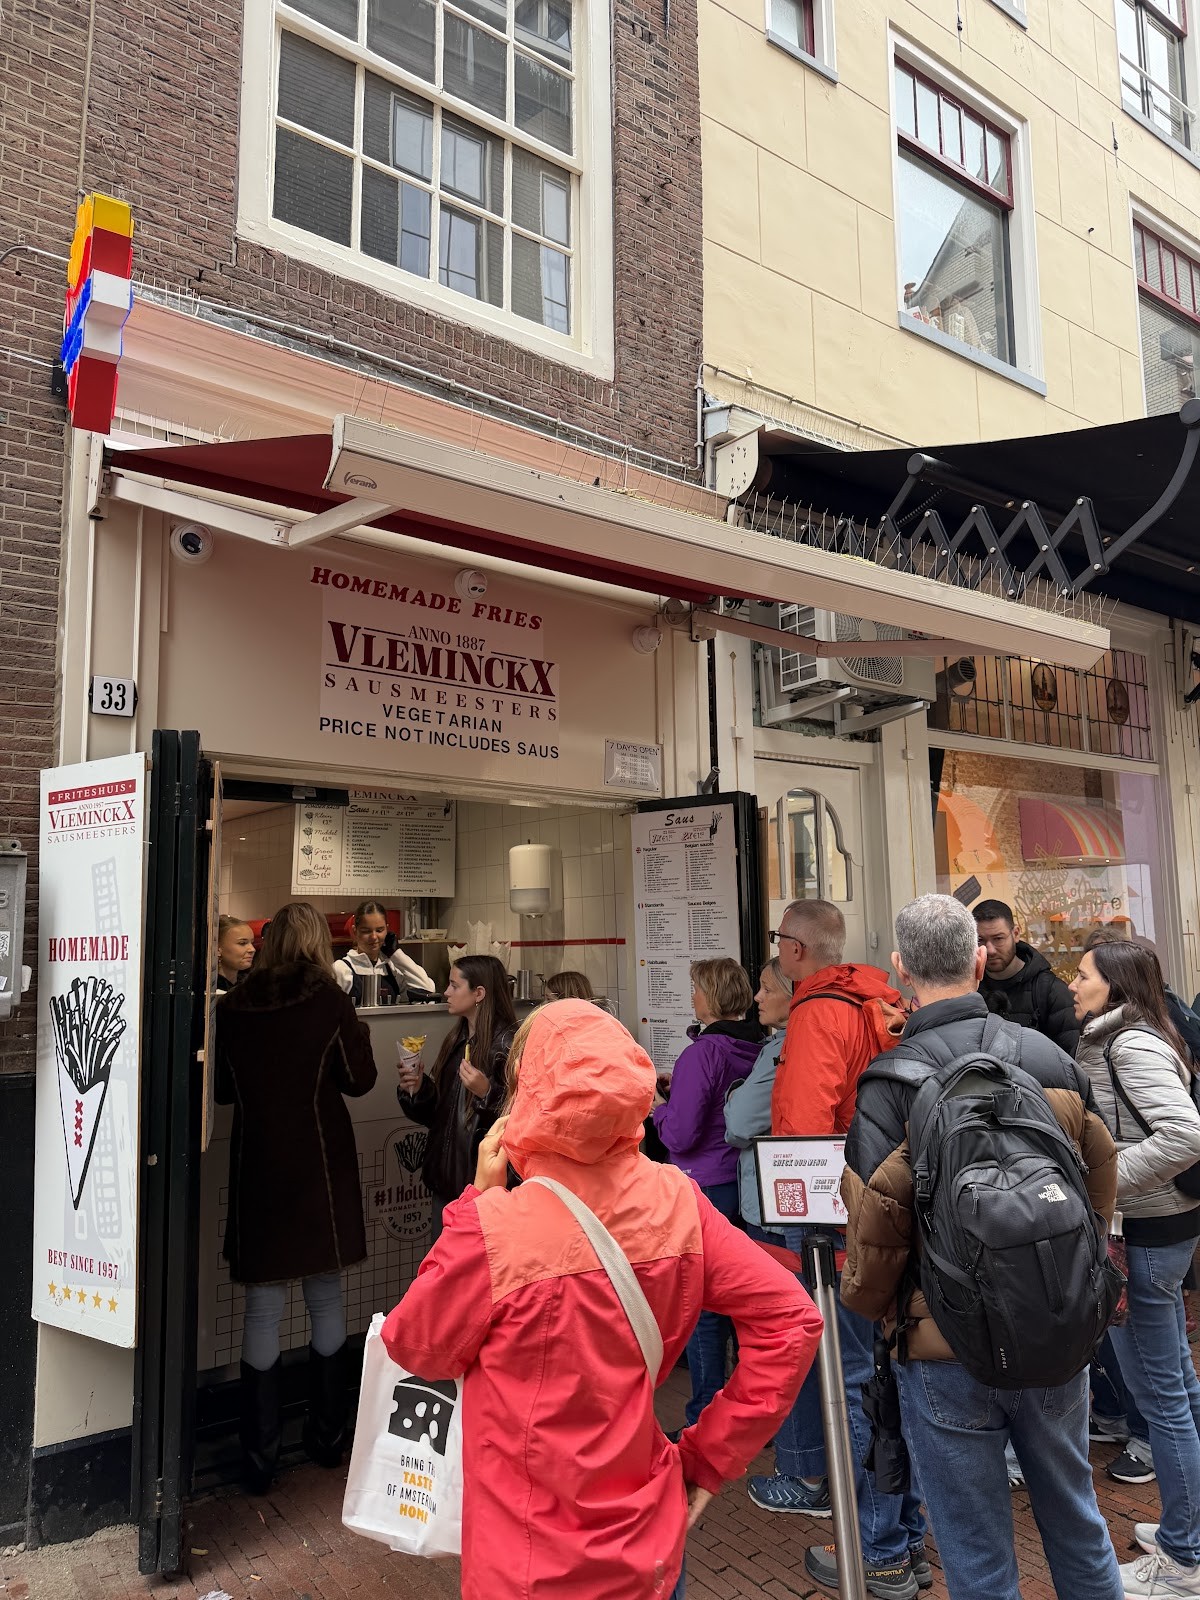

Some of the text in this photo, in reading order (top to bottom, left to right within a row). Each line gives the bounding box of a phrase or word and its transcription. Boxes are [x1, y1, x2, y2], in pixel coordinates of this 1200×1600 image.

[344, 472, 377, 489] Verano
[310, 566, 543, 631] HOMEMADE FRIES
[408, 625, 486, 652] ANNO 1887
[328, 620, 556, 698] VLEMINCKX
[101, 682, 126, 710] 33
[324, 673, 557, 722] SAUSMEESTERS
[382, 703, 502, 734] VEGETARIAN
[319, 717, 560, 760] PRICE NOT INCLUDES SAUS
[616, 742, 638, 752] DAY'S
[639, 746, 658, 756] OPEN
[58, 783, 126, 802] FRITESHUIS
[48, 799, 135, 830] VLEMINCKX
[348, 805, 370, 813] Saus
[665, 814, 694, 826] Saus
[48, 826, 136, 844] SAUSMEESTERS
[48, 935, 129, 962] HOMEMADE
[374, 1187, 392, 1207] #1
[388, 1216, 432, 1234] AMSTERDA
[403, 1211, 422, 1223] 1957
[48, 1248, 118, 1280] BEST SINCE 1957
[401, 1455, 424, 1471] BRING
[387, 1484, 396, 1496] OF
[403, 1471, 432, 1492] TASTE
